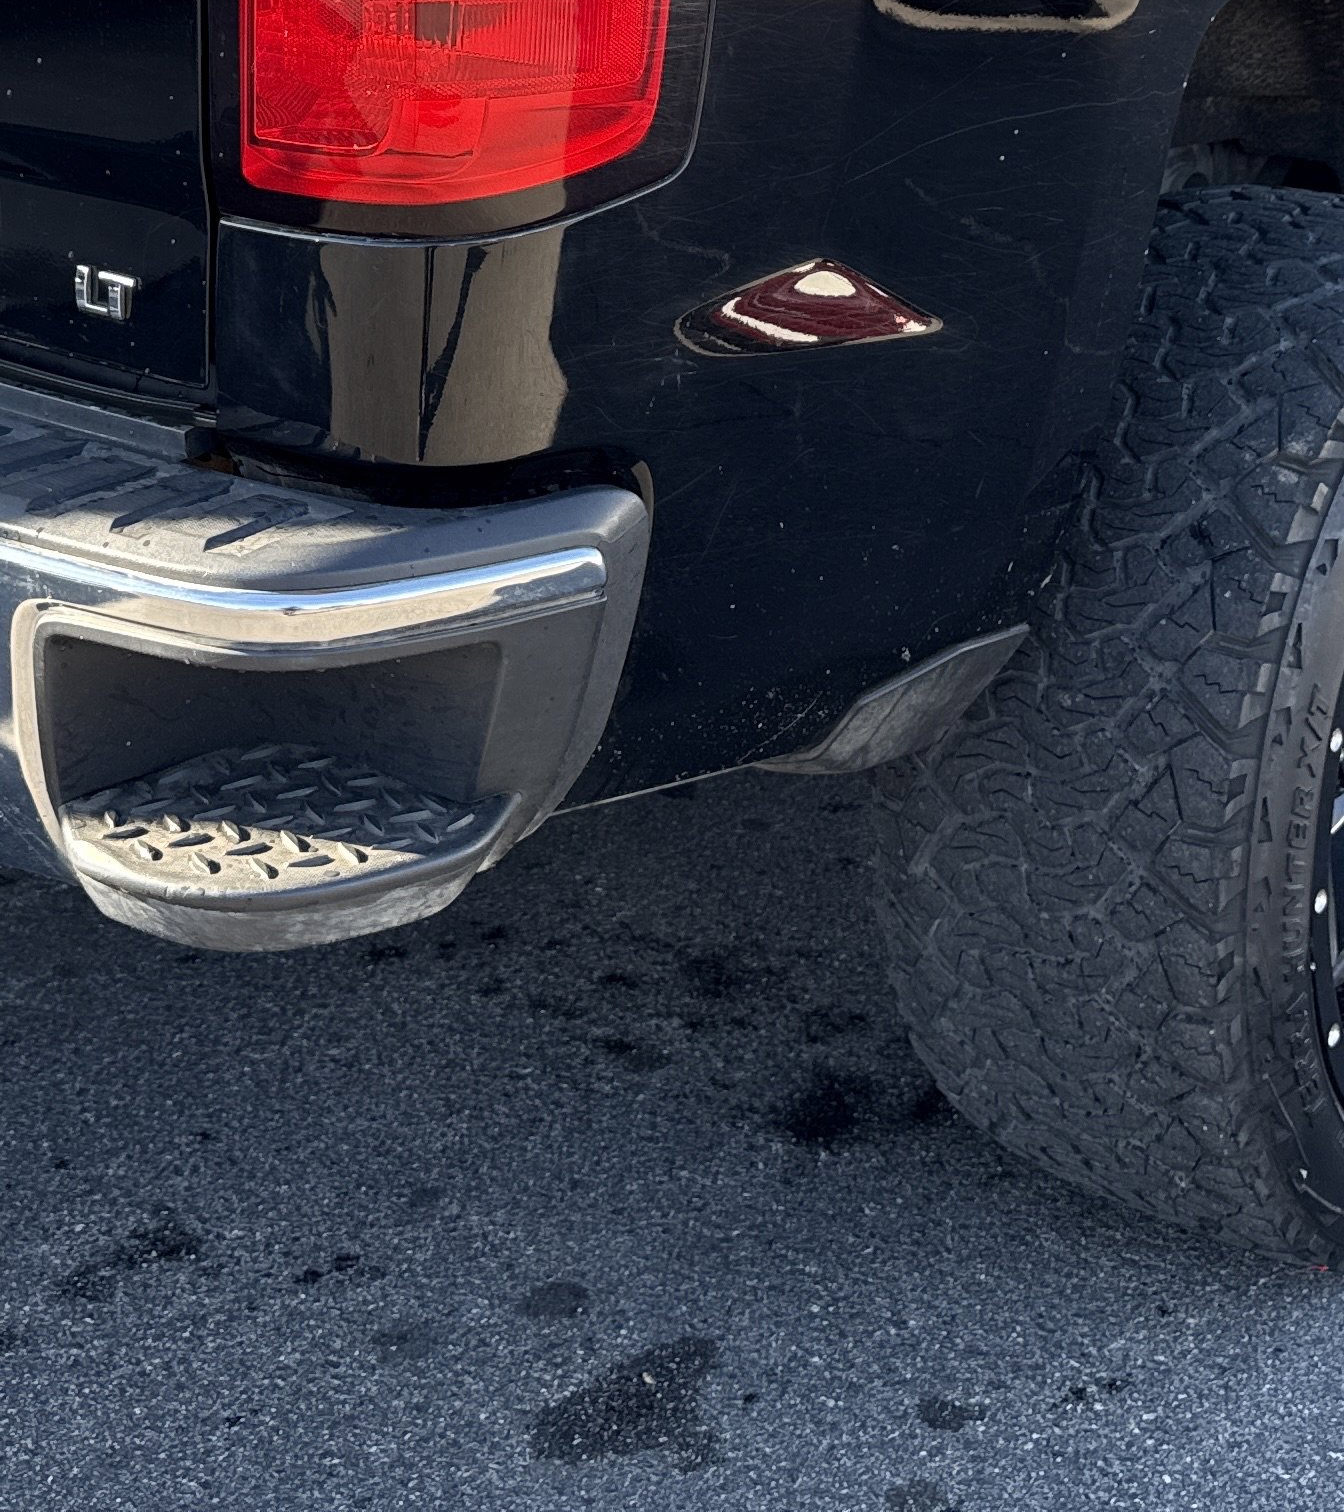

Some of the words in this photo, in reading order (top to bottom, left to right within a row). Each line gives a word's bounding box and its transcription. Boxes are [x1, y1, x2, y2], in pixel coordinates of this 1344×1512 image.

[74, 264, 138, 321] LT
[1296, 683, 1330, 779] X/T
[1281, 786, 1314, 983] HUNTER
